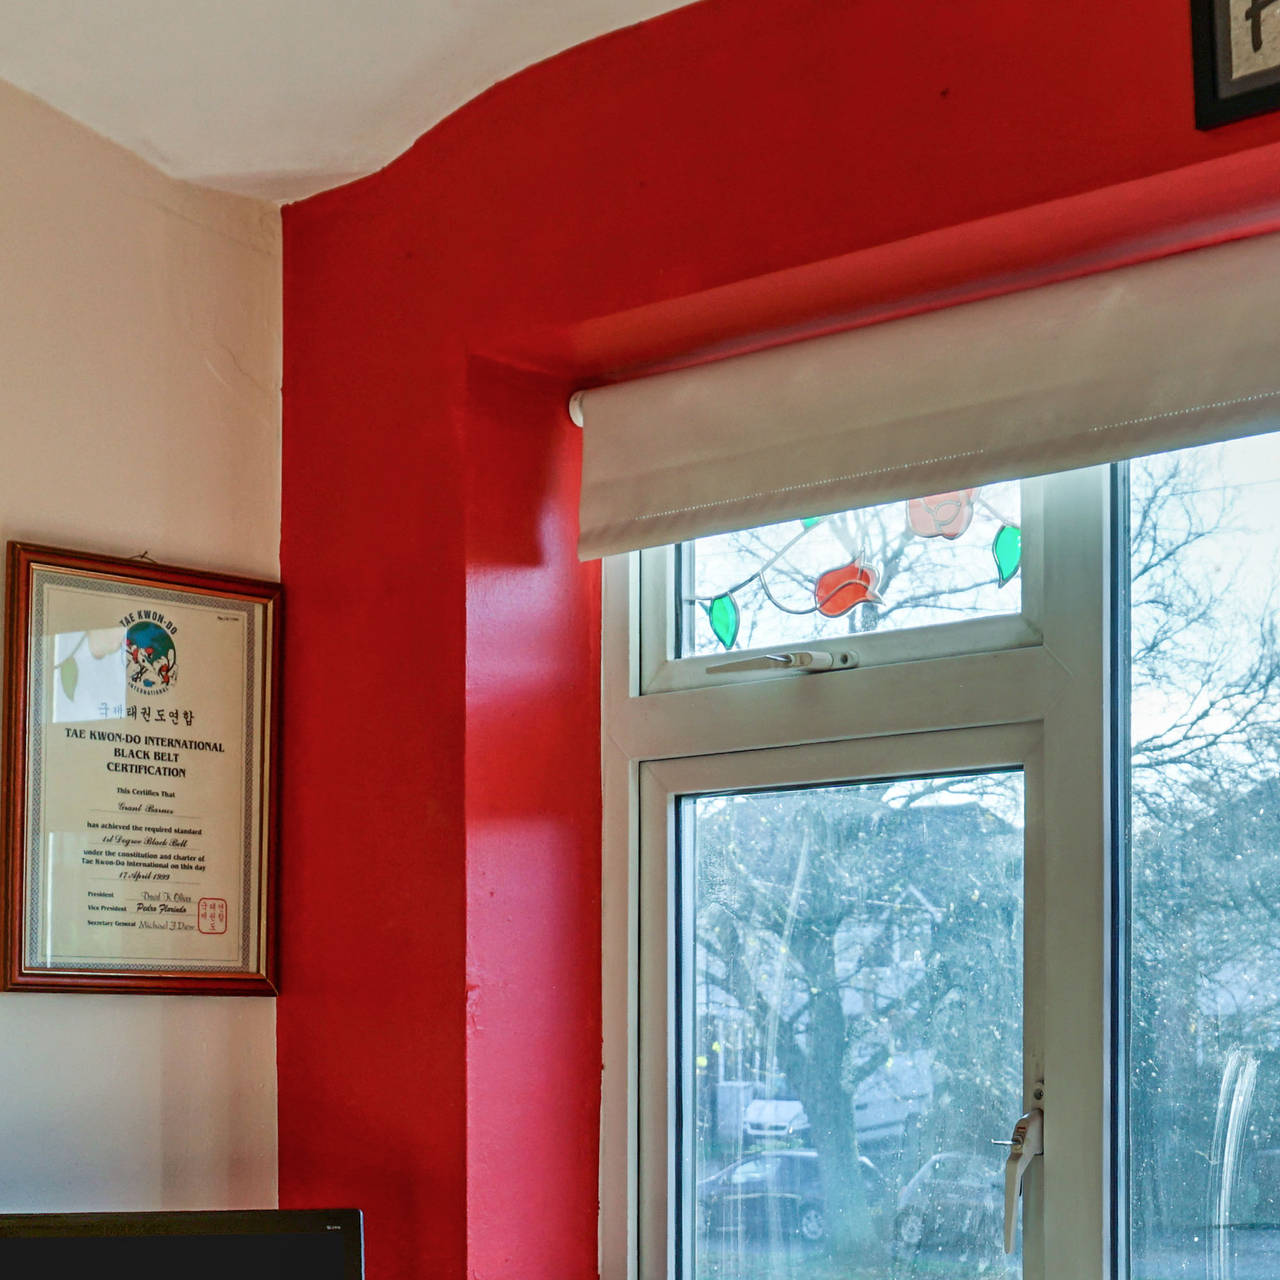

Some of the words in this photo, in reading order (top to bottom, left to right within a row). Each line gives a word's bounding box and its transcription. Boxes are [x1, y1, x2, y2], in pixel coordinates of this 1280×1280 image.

[120, 612, 136, 628] TAE
[136, 609, 178, 636] KWON-DO
[65, 727, 86, 739] TAE
[89, 730, 142, 745] KWON-DO
[144, 735, 225, 753] INTERNATIONAL
[114, 747, 151, 760] BLACK
[153, 751, 180, 763] BELT
[106, 761, 187, 778] CERTIFICATION
[116, 786, 131, 795] This
[161, 790, 176, 798] That
[87, 820, 100, 829] has
[132, 824, 144, 832] the
[144, 825, 173, 835] required
[105, 849, 116, 857] the
[159, 853, 172, 861] and
